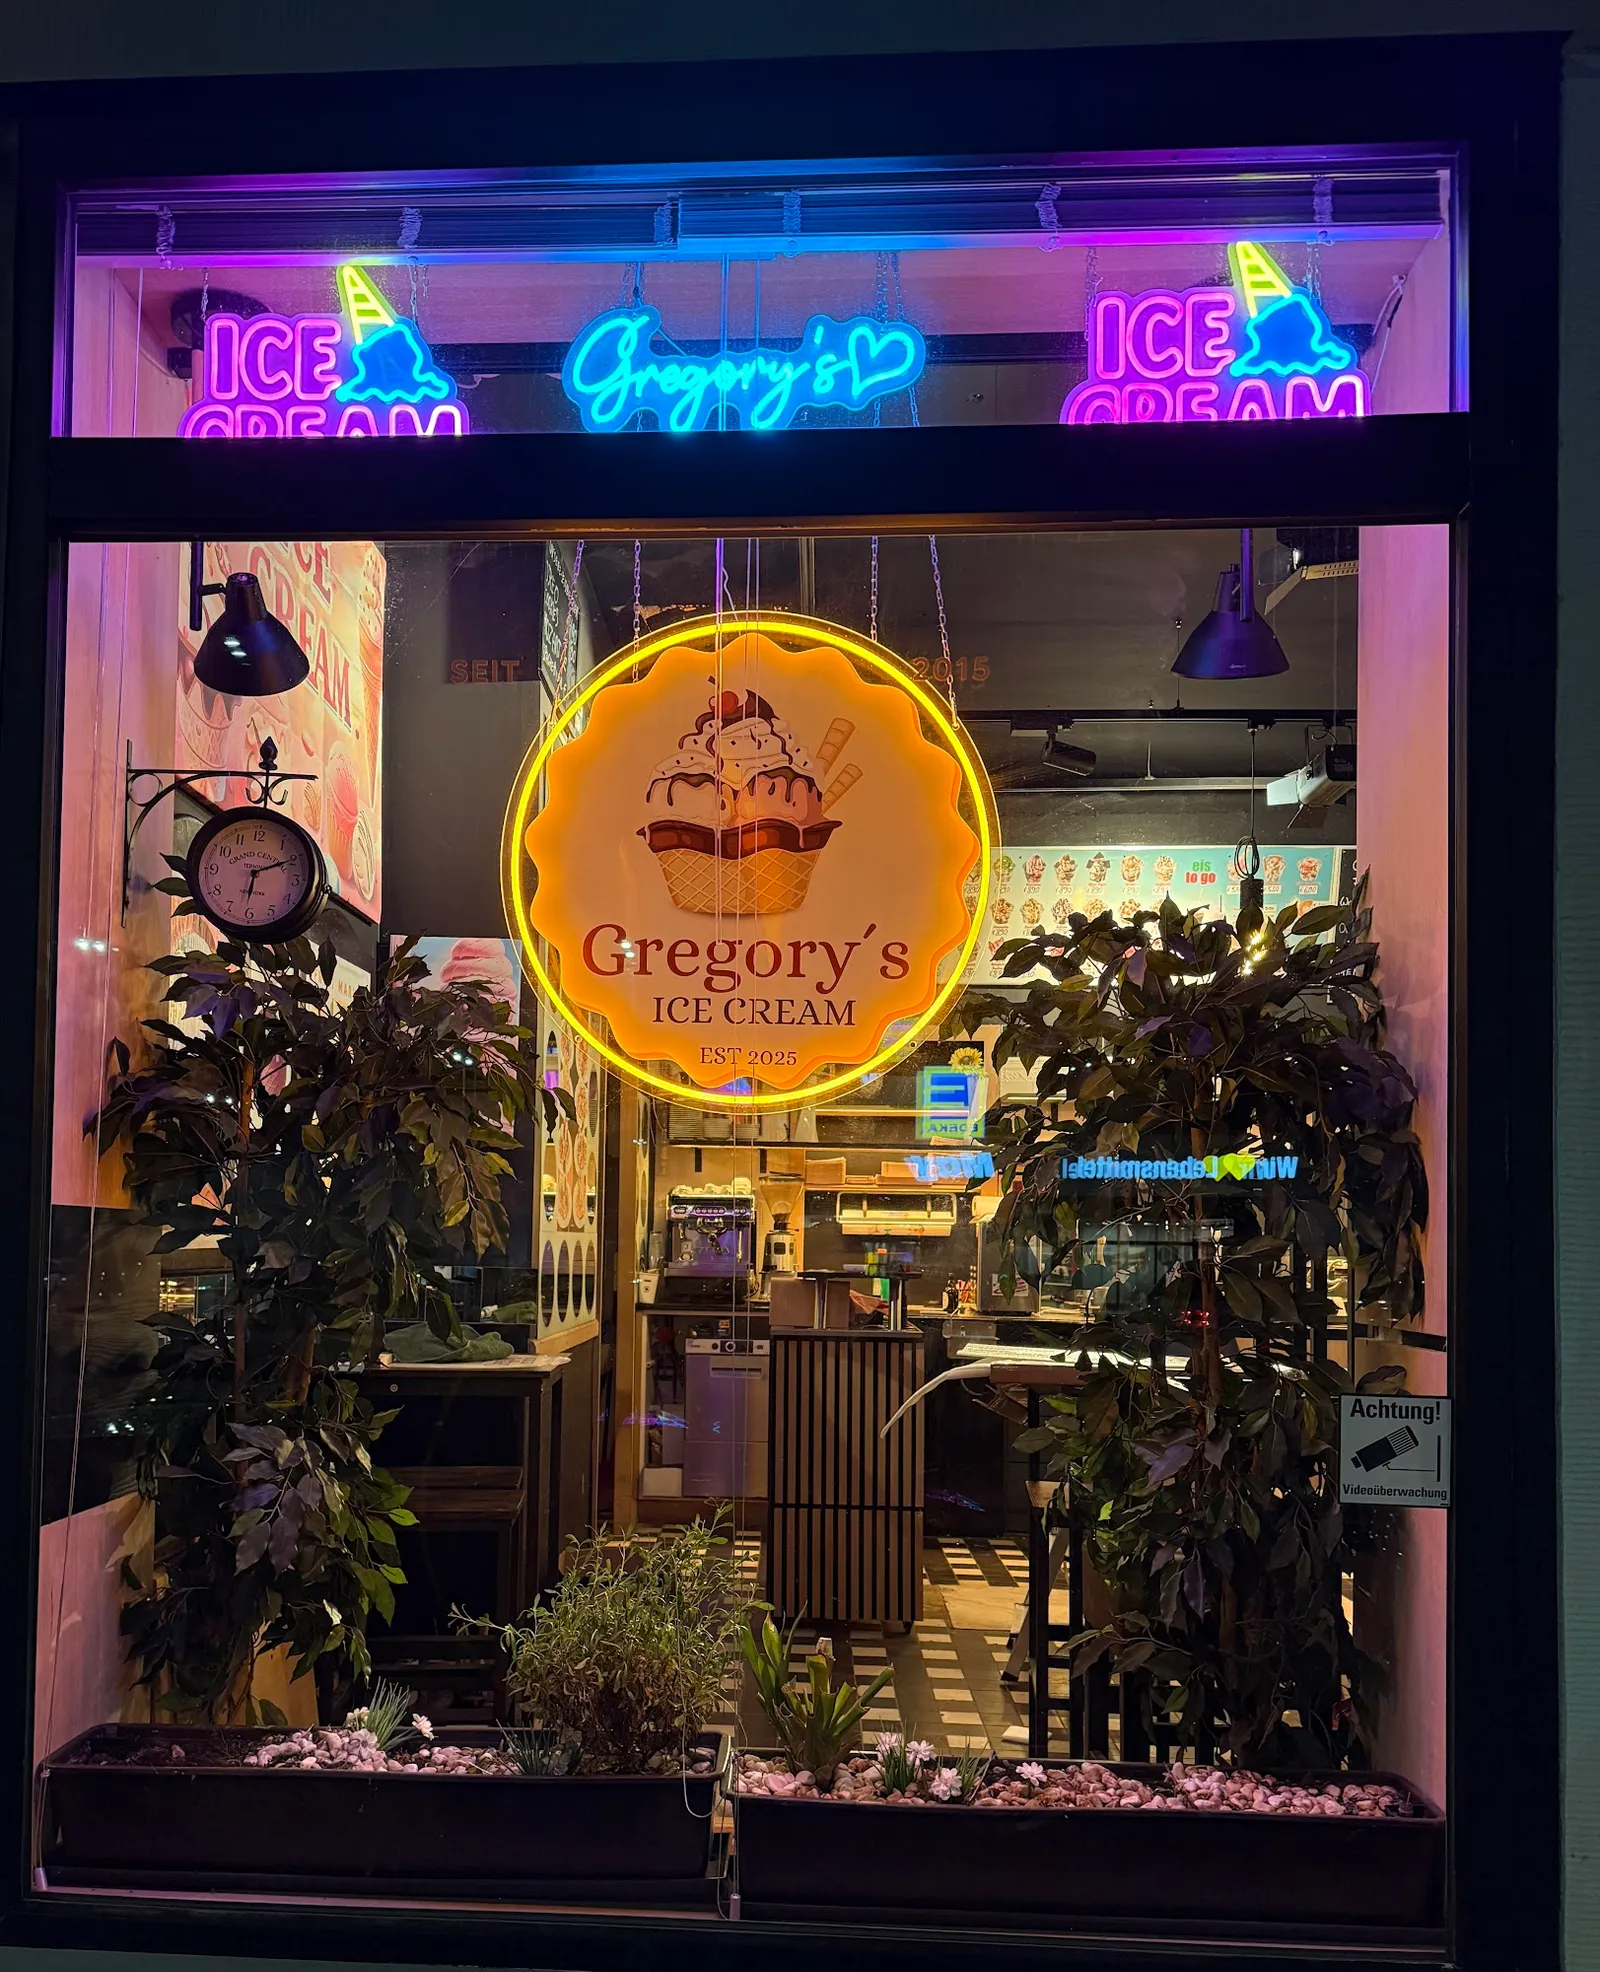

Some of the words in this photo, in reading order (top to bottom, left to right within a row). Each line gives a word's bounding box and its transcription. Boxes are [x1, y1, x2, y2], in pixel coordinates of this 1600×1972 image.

[1095, 292, 1236, 381] ICE
[210, 318, 343, 401] ICE
[573, 315, 850, 432] Gregory's
[450, 659, 520, 684] SEIT
[912, 656, 990, 682] 2015
[229, 851, 256, 866] GRAND
[1192, 859, 1212, 872] eis
[1185, 872, 1198, 884] to
[1200, 872, 1216, 885] go
[652, 996, 712, 1024] ICE
[723, 997, 857, 1027] CREAM
[699, 1046, 742, 1066] EST
[747, 1049, 797, 1067] 2025
[1349, 1398, 1441, 1425] Achtung!
[1342, 1483, 1448, 1501] Videoüberwachung
